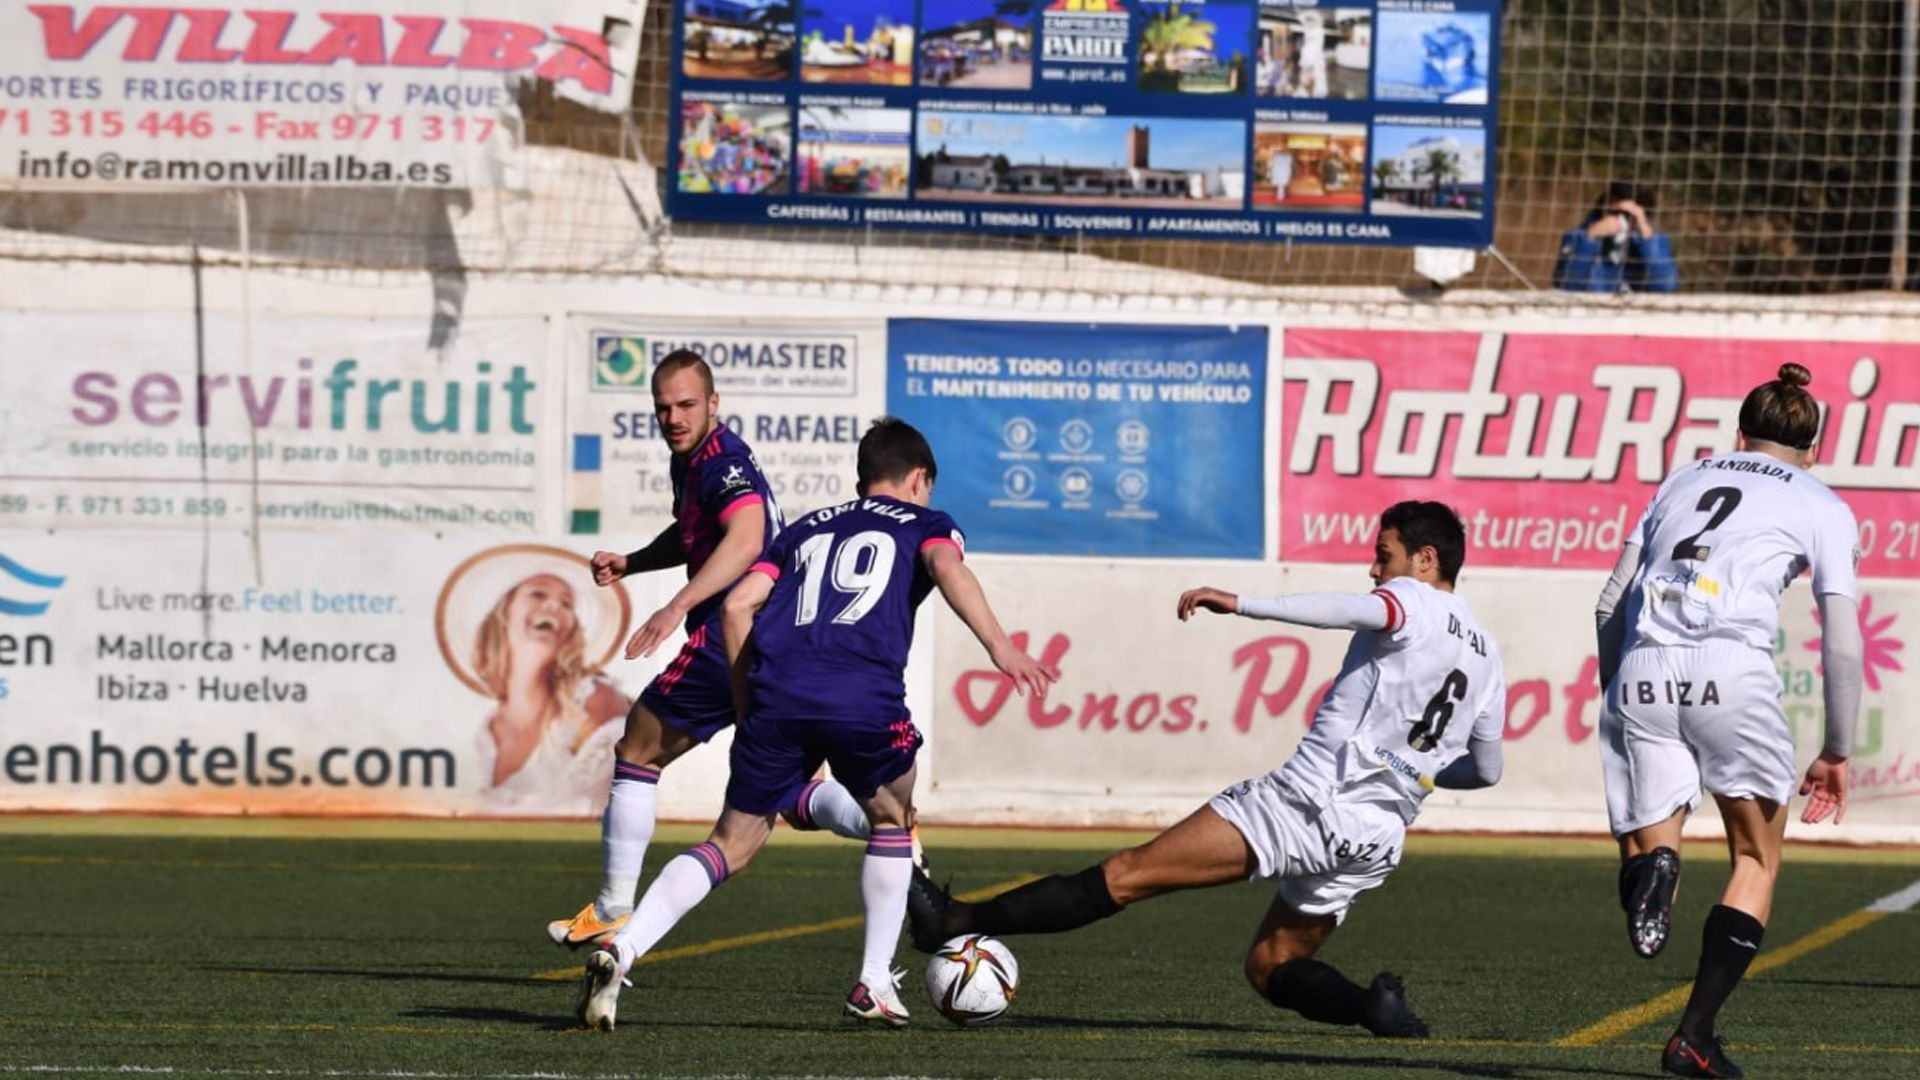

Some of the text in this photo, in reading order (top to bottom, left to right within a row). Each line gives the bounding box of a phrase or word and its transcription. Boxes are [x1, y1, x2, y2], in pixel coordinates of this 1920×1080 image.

[1044, 17, 1129, 32] EMPRESAS
[26, 4, 614, 96] VILLALBA
[1044, 36, 1125, 58] PAROT
[0, 75, 101, 100] ORTES
[124, 73, 344, 104] FRIGORÍFICOS
[366, 82, 383, 103] Y
[1042, 67, 1127, 83] www.parot.es
[49, 109, 125, 138] 315
[137, 111, 214, 138] 446
[254, 111, 320, 140] Fax
[331, 114, 404, 141] 971
[421, 116, 498, 144] 317
[18, 150, 454, 185] info@ramonvillalba.es
[767, 203, 1391, 238] CAFETERÍAS RESTAURANTES TIENDAS SOUVENIRS APARTAMENTOS HIELOS ES CANA
[905, 354, 1251, 380] TENEMOS TODO LO NECESARIO PARA
[71, 359, 536, 434] servifruit
[908, 378, 1252, 404] EL MANTENIMIENTO DE TU VEHÍCULO
[756, 413, 863, 445] RAFAEL
[69, 440, 168, 459] servicio
[176, 440, 274, 463] integral
[282, 447, 338, 464] para
[348, 444, 369, 462] la
[794, 472, 841, 496] 670
[82, 496, 123, 514] 971
[134, 497, 174, 515] 331
[184, 498, 227, 517] 859
[806, 501, 857, 527] TONI
[863, 499, 917, 524] VILLA
[1670, 486, 1742, 561] 2
[794, 530, 898, 627] 19
[96, 588, 152, 611] Live
[312, 591, 403, 615] better.
[97, 635, 396, 663] Mallorca Menorca
[97, 676, 308, 703] Ibiza Huelva
[1621, 679, 1720, 706] IBIZA
[1407, 667, 1468, 753] 6
[5, 730, 457, 789] enhotels.com
